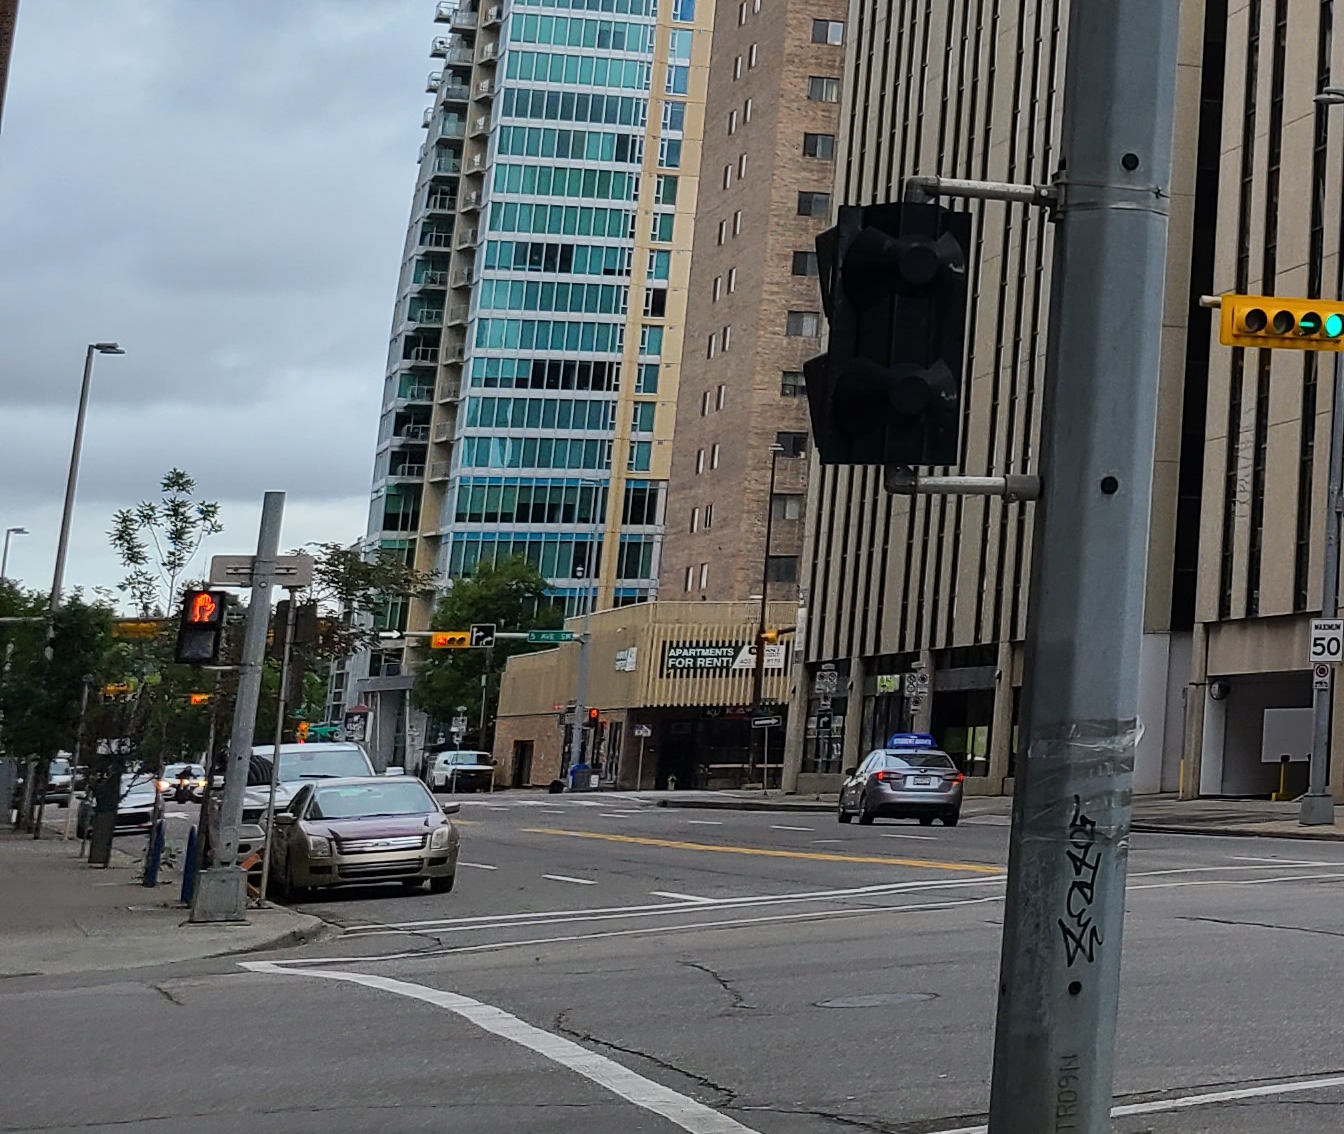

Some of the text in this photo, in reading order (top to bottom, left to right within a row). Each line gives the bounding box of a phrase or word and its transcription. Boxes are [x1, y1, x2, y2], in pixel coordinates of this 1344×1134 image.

[668, 648, 734, 657] APARTMENTS
[1312, 637, 1341, 656] 50
[668, 656, 732, 668] FOR RENT!
